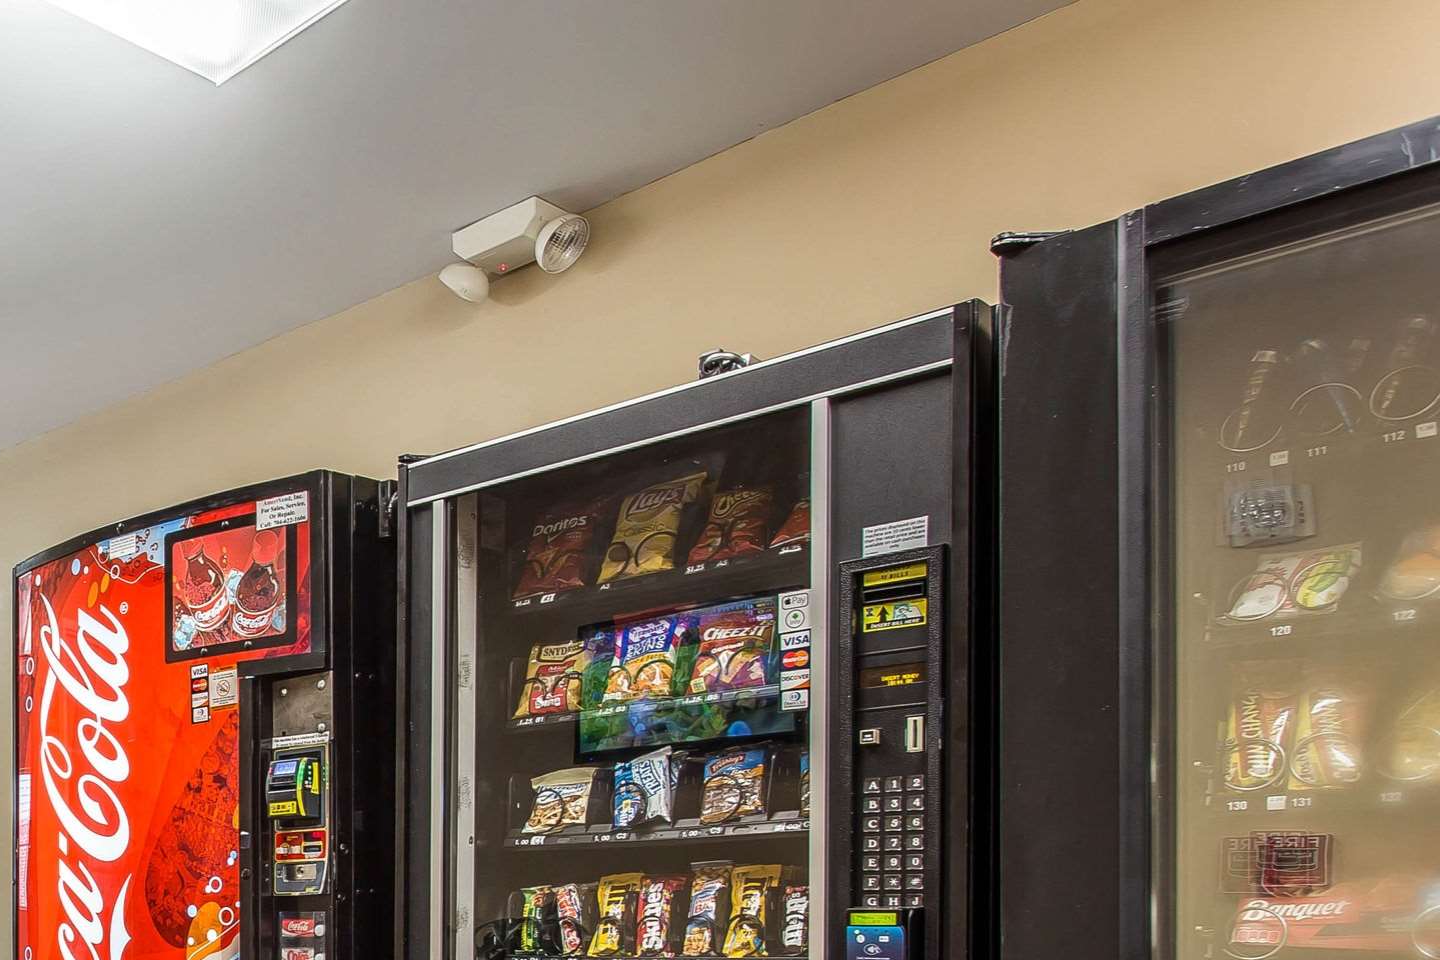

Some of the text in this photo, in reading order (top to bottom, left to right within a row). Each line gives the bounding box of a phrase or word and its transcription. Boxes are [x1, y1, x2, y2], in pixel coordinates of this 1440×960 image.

[1383, 430, 1405, 442] 112
[1307, 446, 1328, 457] 111
[1227, 461, 1246, 472] 110
[533, 516, 588, 541] Doritos
[685, 564, 704, 574] $1.25
[704, 623, 766, 641] CHEEZ-IT
[784, 635, 809, 647] VISA
[193, 667, 207, 676] VISA
[639, 760, 661, 797] TREATS
[869, 778, 921, 790] A 1 2
[869, 798, 921, 809] B 3 4
[1227, 801, 1248, 811] 130
[868, 818, 920, 828] C 5 6
[868, 837, 920, 848] D 7 8
[868, 857, 920, 867] E 9 0
[868, 878, 877, 886] F
[867, 896, 919, 906] G H J
[1242, 900, 1351, 921] Banquet
